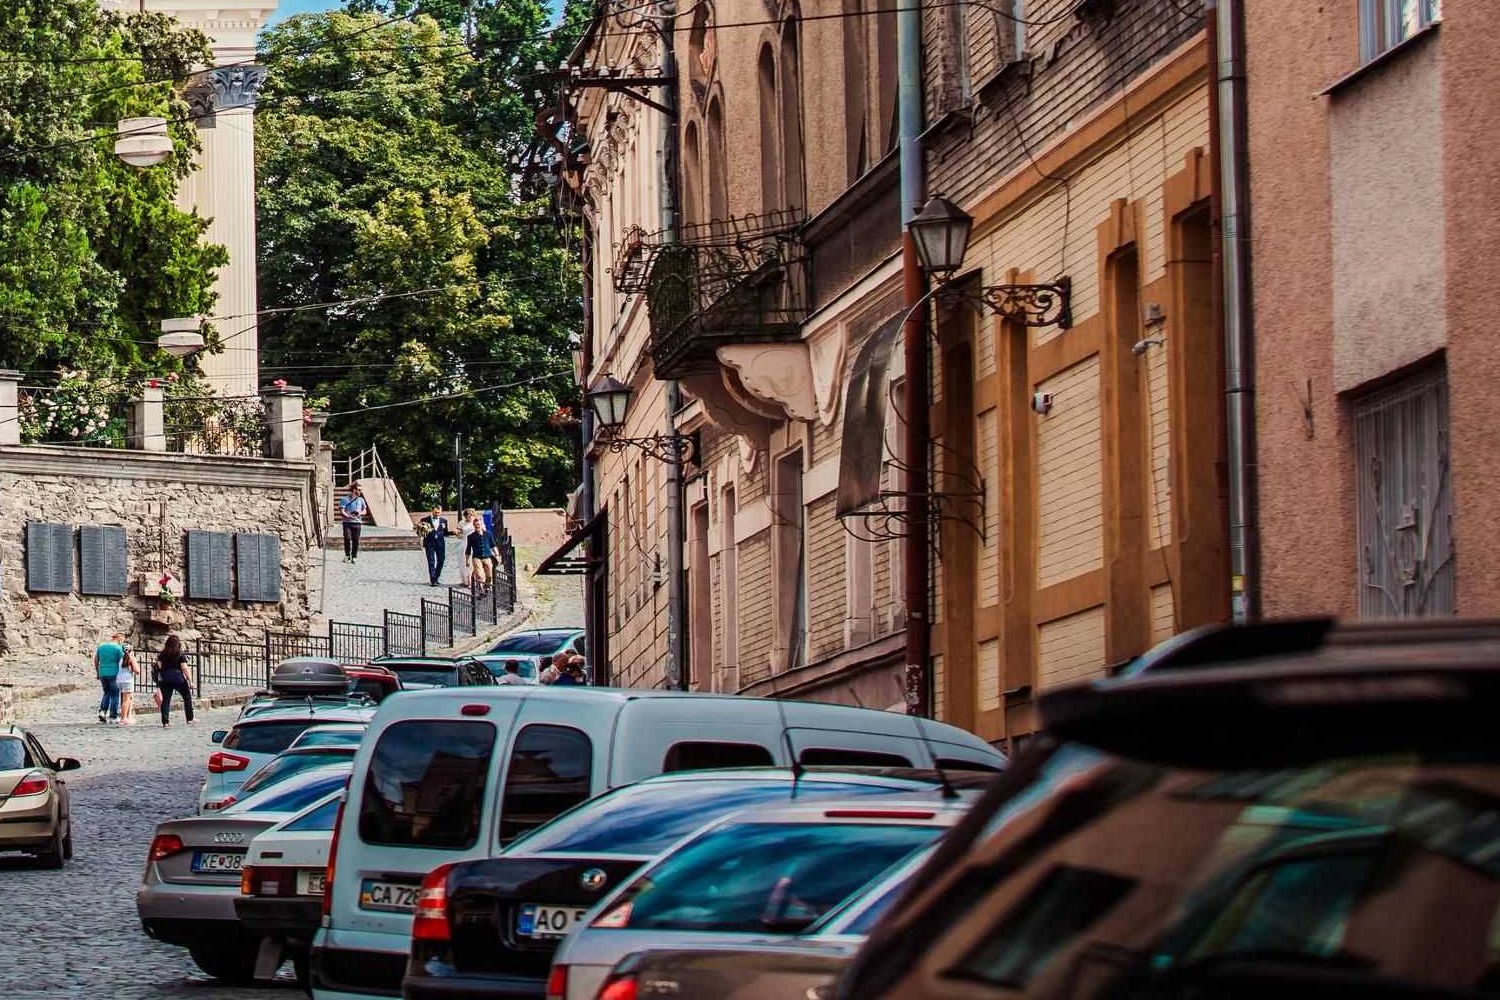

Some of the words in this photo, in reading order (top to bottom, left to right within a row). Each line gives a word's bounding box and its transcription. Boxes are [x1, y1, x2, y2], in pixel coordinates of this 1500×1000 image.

[201, 854, 219, 868] KE
[372, 886, 391, 903] CA
[535, 909, 567, 930] AO
